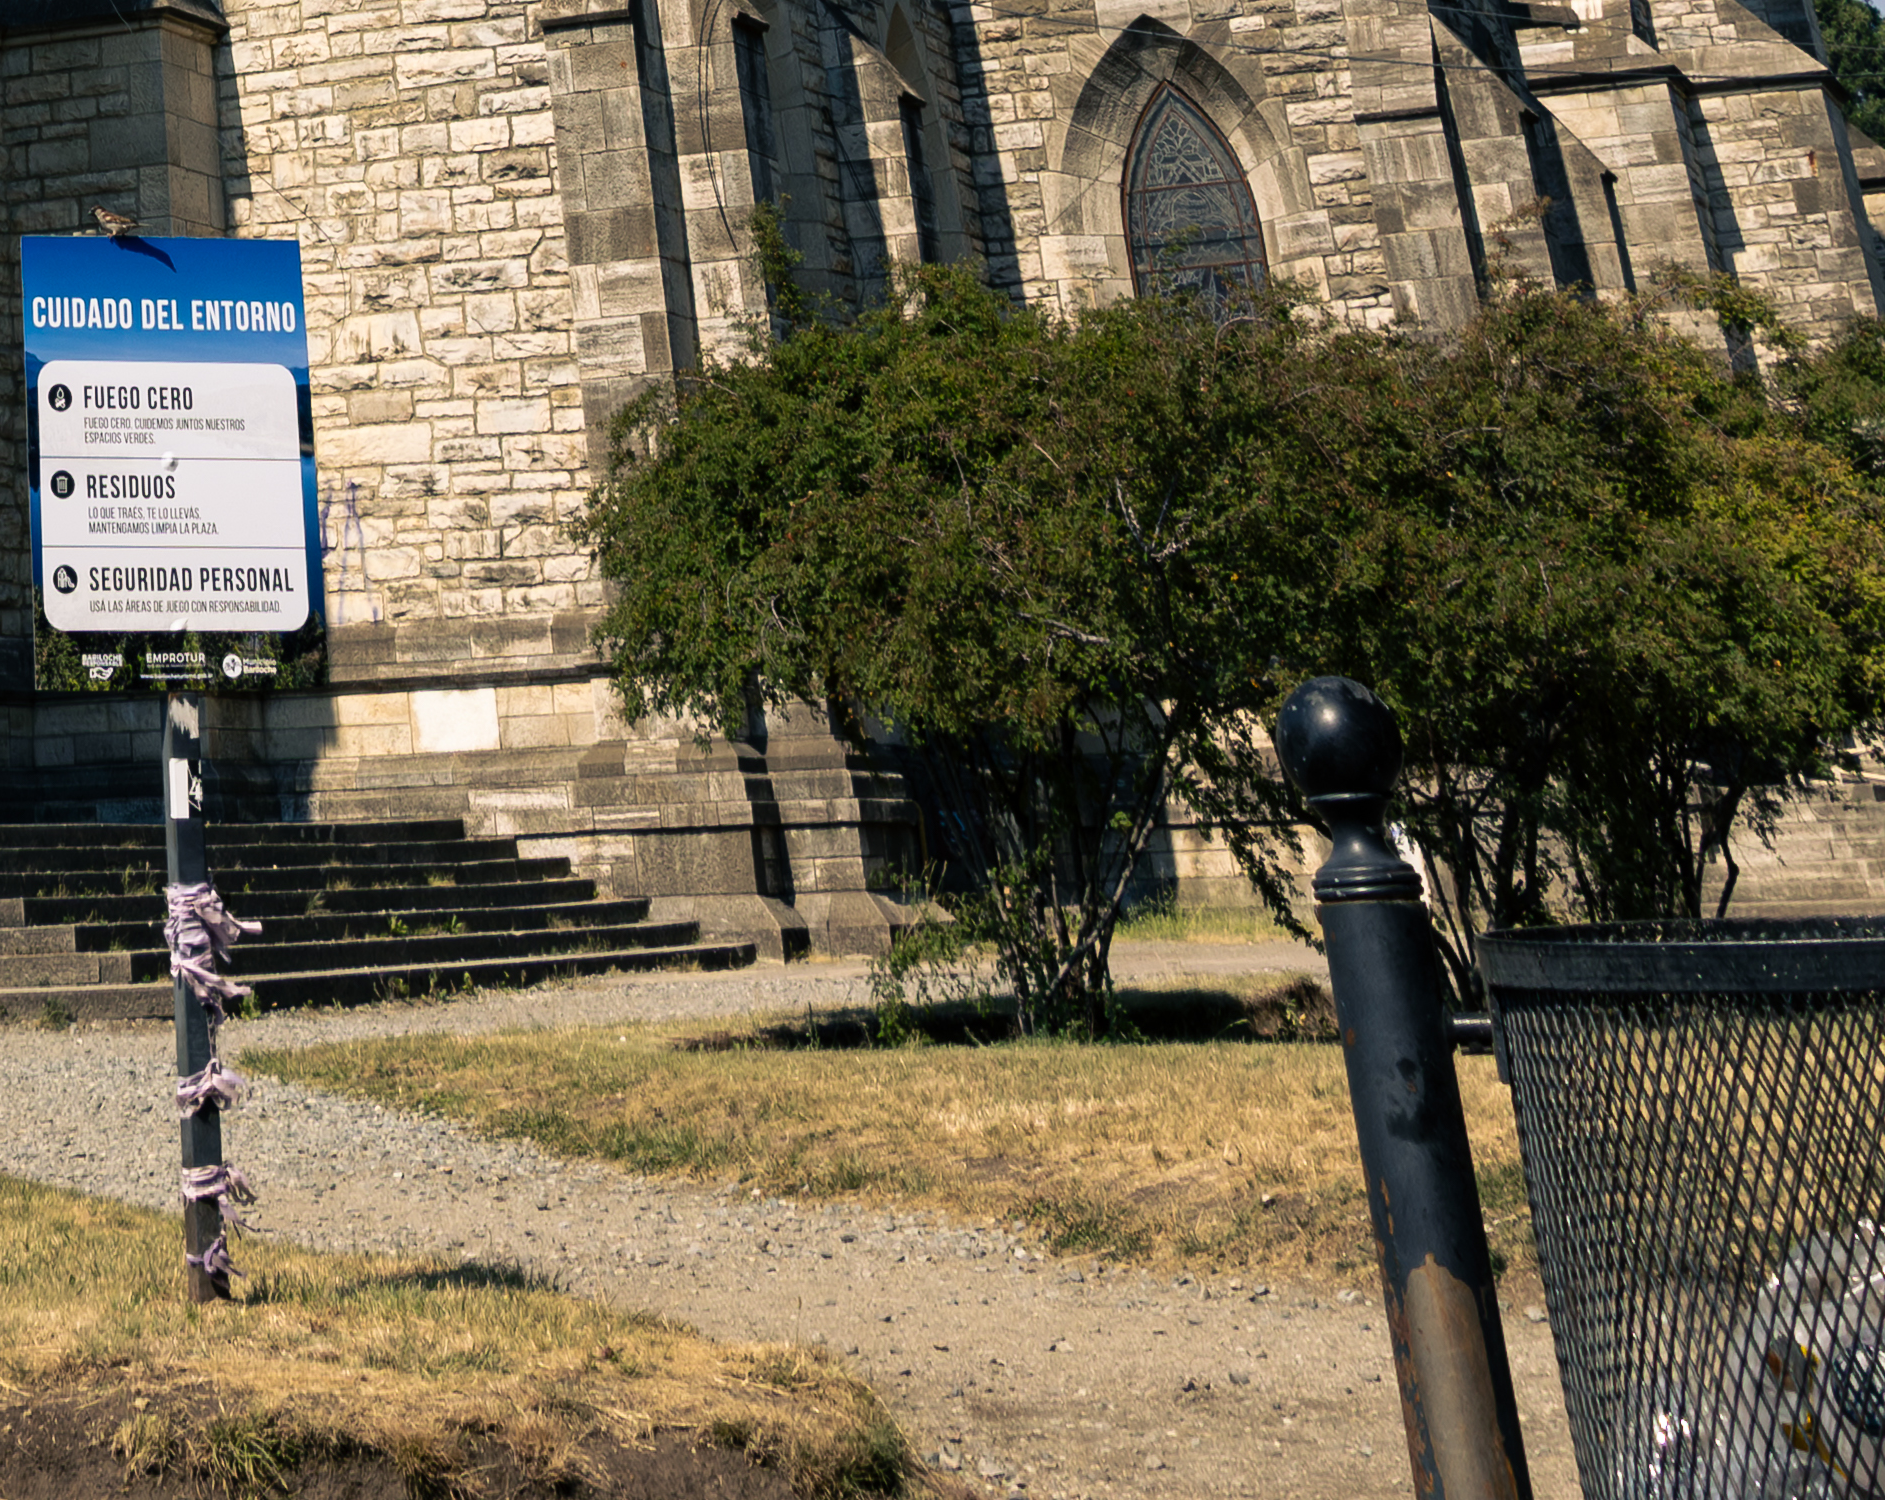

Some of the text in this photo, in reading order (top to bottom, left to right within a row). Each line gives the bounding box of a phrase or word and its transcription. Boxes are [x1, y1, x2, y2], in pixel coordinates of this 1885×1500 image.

[32, 296, 296, 333] CUIDADO DEL ENTORNO
[83, 385, 193, 410] FUEGO CERO
[84, 417, 109, 429] FUEGO
[134, 417, 173, 430] CUIDEMOS
[175, 418, 204, 431] JUNTOS
[205, 418, 246, 431] NUESTROS
[84, 431, 156, 445] ESPACIOS VERDES.
[86, 474, 176, 499] RESIDUOS
[88, 506, 98, 519] LO
[100, 506, 116, 519] QUE
[147, 507, 157, 520] TE
[158, 507, 168, 520] LO
[88, 521, 219, 535] MANTENGAMOS LIMPIA LA PLAZA.
[89, 566, 294, 592] SEGURIDAD PERSONAL
[89, 598, 282, 614] USÁ LAS ÁREAS DE JUEGO CON RESPONSABILIDAD.
[145, 652, 205, 664] EMPROTUR
